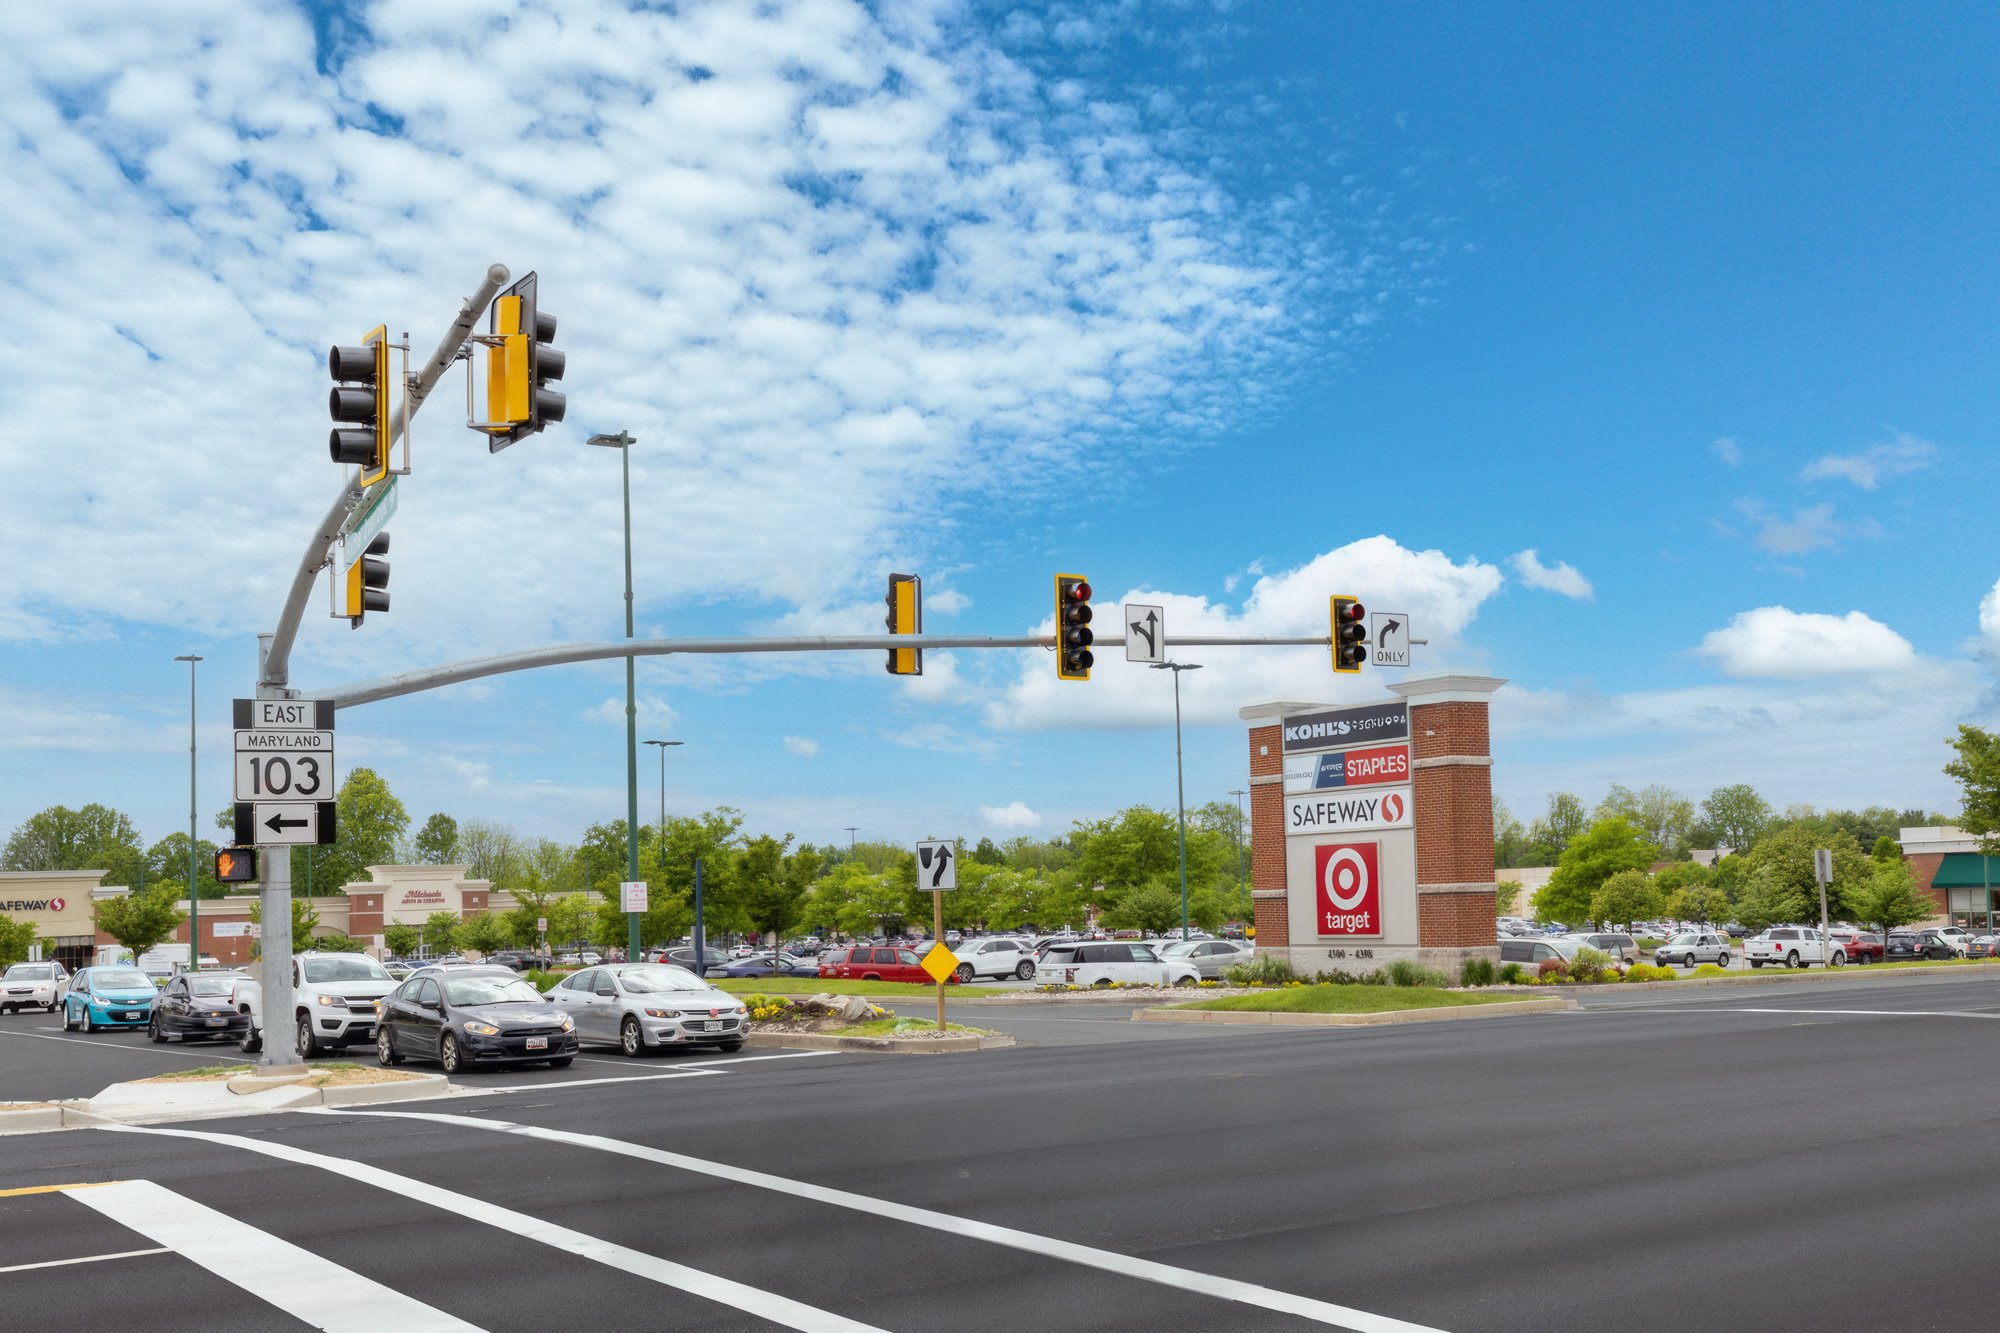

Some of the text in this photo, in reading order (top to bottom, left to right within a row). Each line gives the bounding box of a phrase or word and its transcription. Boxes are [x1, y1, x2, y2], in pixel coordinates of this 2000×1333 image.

[1377, 651, 1405, 662] ONLY
[263, 704, 305, 723] EAST
[248, 735, 321, 747] MARYLAND
[1285, 721, 1351, 742] KOHL'S
[250, 756, 320, 795] 103
[1347, 754, 1407, 777] STAPLES
[1292, 798, 1378, 827] SAFEWAY
[1326, 911, 1370, 933] target
